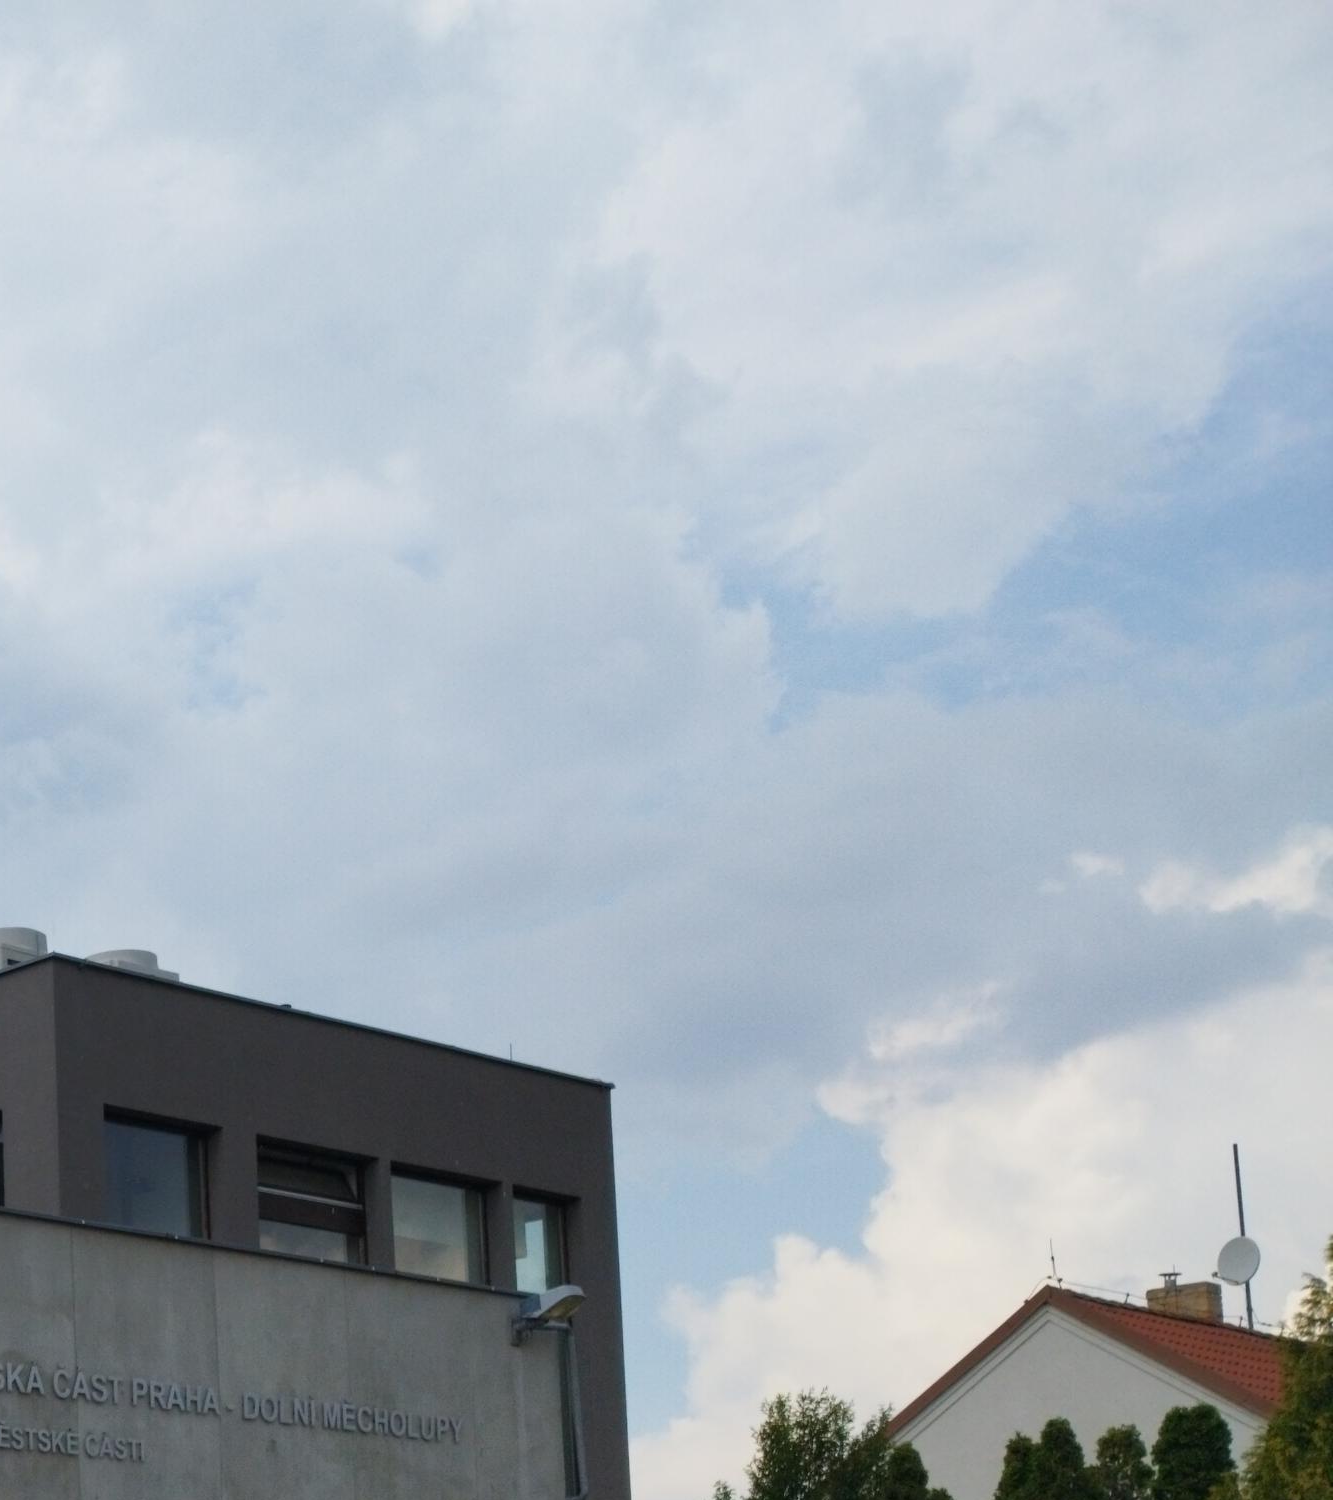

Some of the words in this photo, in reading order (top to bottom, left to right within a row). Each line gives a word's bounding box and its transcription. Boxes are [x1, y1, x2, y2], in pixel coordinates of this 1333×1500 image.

[52, 1364, 122, 1406] ČÁST
[131, 1377, 221, 1416] PRAHA
[242, 1390, 318, 1428] DOLNÍ
[321, 1399, 465, 1444] MĚCHOLUPY
